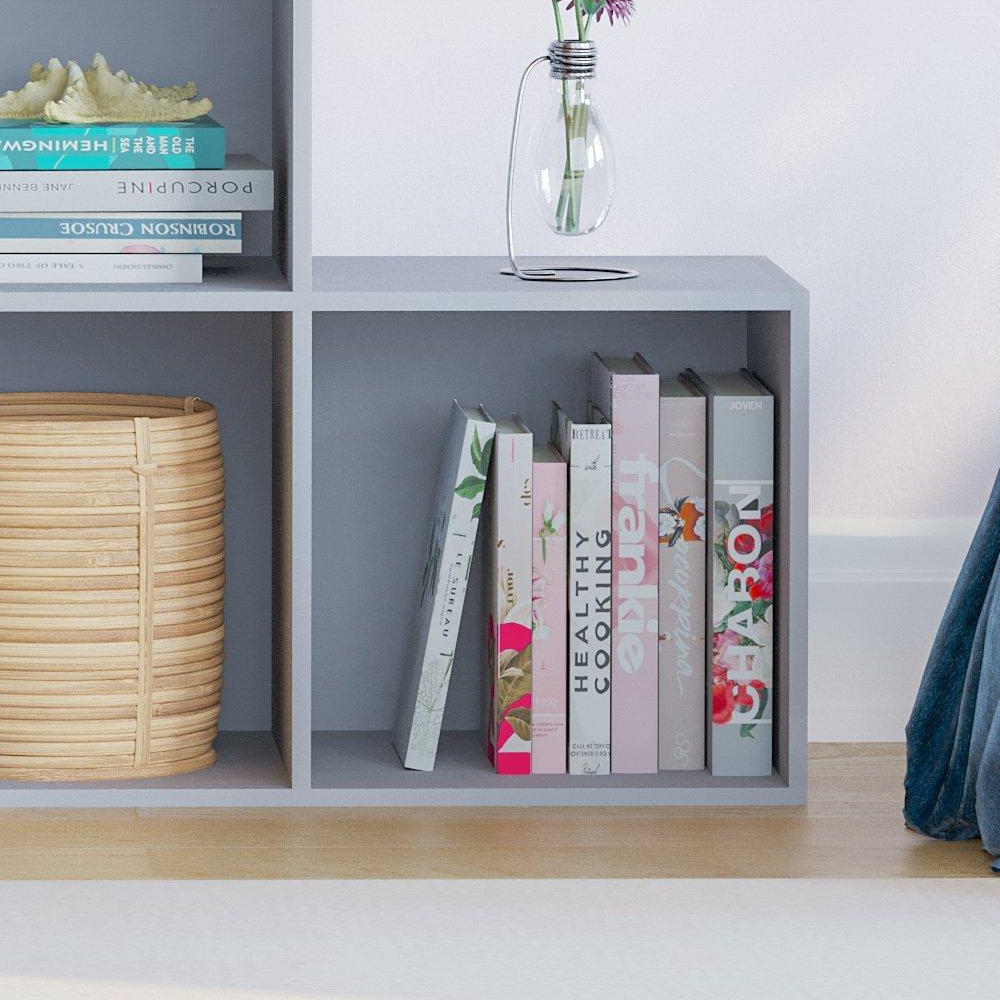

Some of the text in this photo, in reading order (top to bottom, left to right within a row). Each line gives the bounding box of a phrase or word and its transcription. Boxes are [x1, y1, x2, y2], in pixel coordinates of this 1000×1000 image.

[119, 136, 130, 154] SEA
[133, 136, 143, 154] THE
[146, 135, 156, 155] AND
[158, 135, 169, 155] MAN
[172, 136, 182, 154] OLD
[185, 136, 195, 153] THE
[43, 182, 75, 192] JANE
[117, 180, 253, 194] PORCUPINE
[59, 221, 237, 237] ROBINSON CRUSOE
[728, 400, 763, 411] JOVEN
[572, 428, 611, 440] RETREAT
[616, 452, 658, 674] frankie
[442, 576, 459, 638] SUREAU
[574, 531, 590, 693] HEALTHY
[594, 529, 612, 695] COOKING
[726, 484, 763, 722] CHABON
